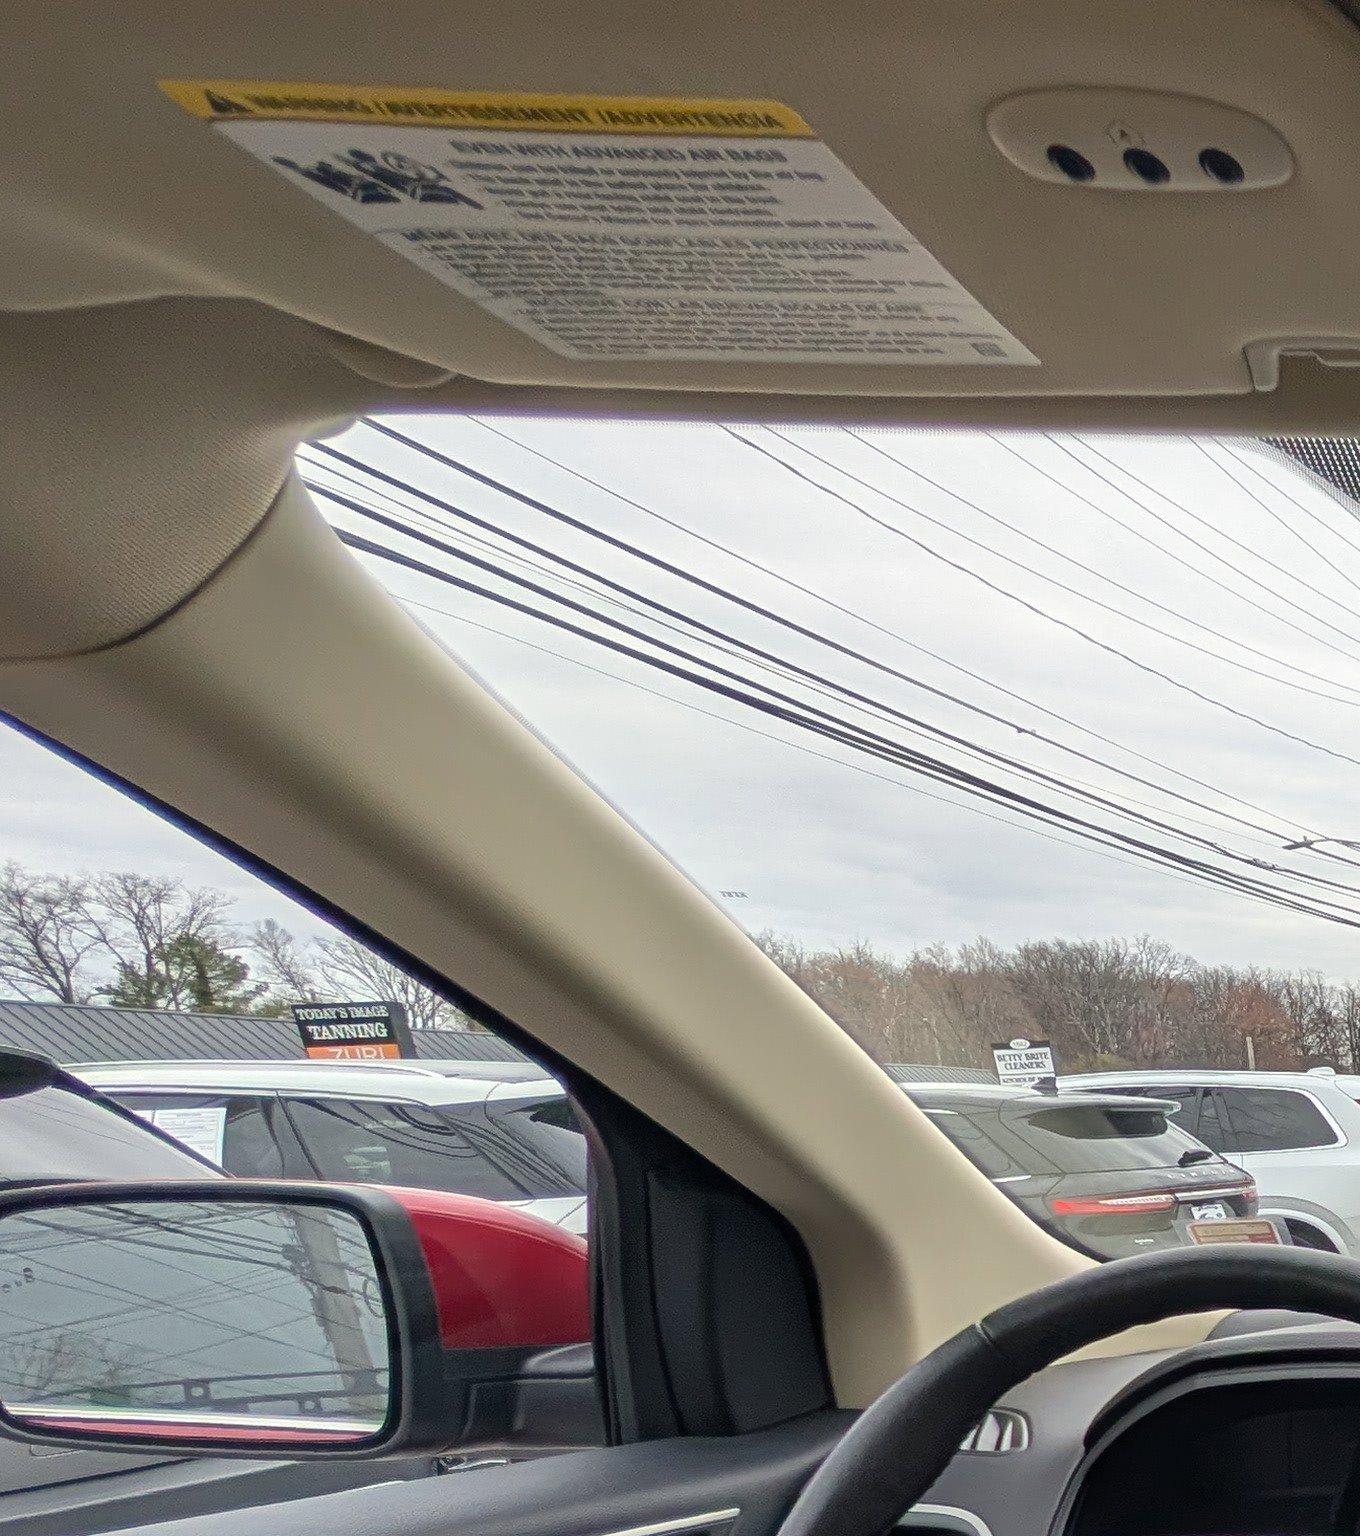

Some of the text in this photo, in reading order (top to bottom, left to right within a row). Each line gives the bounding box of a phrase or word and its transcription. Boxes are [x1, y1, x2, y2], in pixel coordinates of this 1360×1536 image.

[295, 1005, 390, 1021] TODAY'S IMAGE
[306, 1022, 389, 1040] TANNING
[997, 1053, 1022, 1062] BETTY
[1004, 1060, 1046, 1071] CLEANERS
